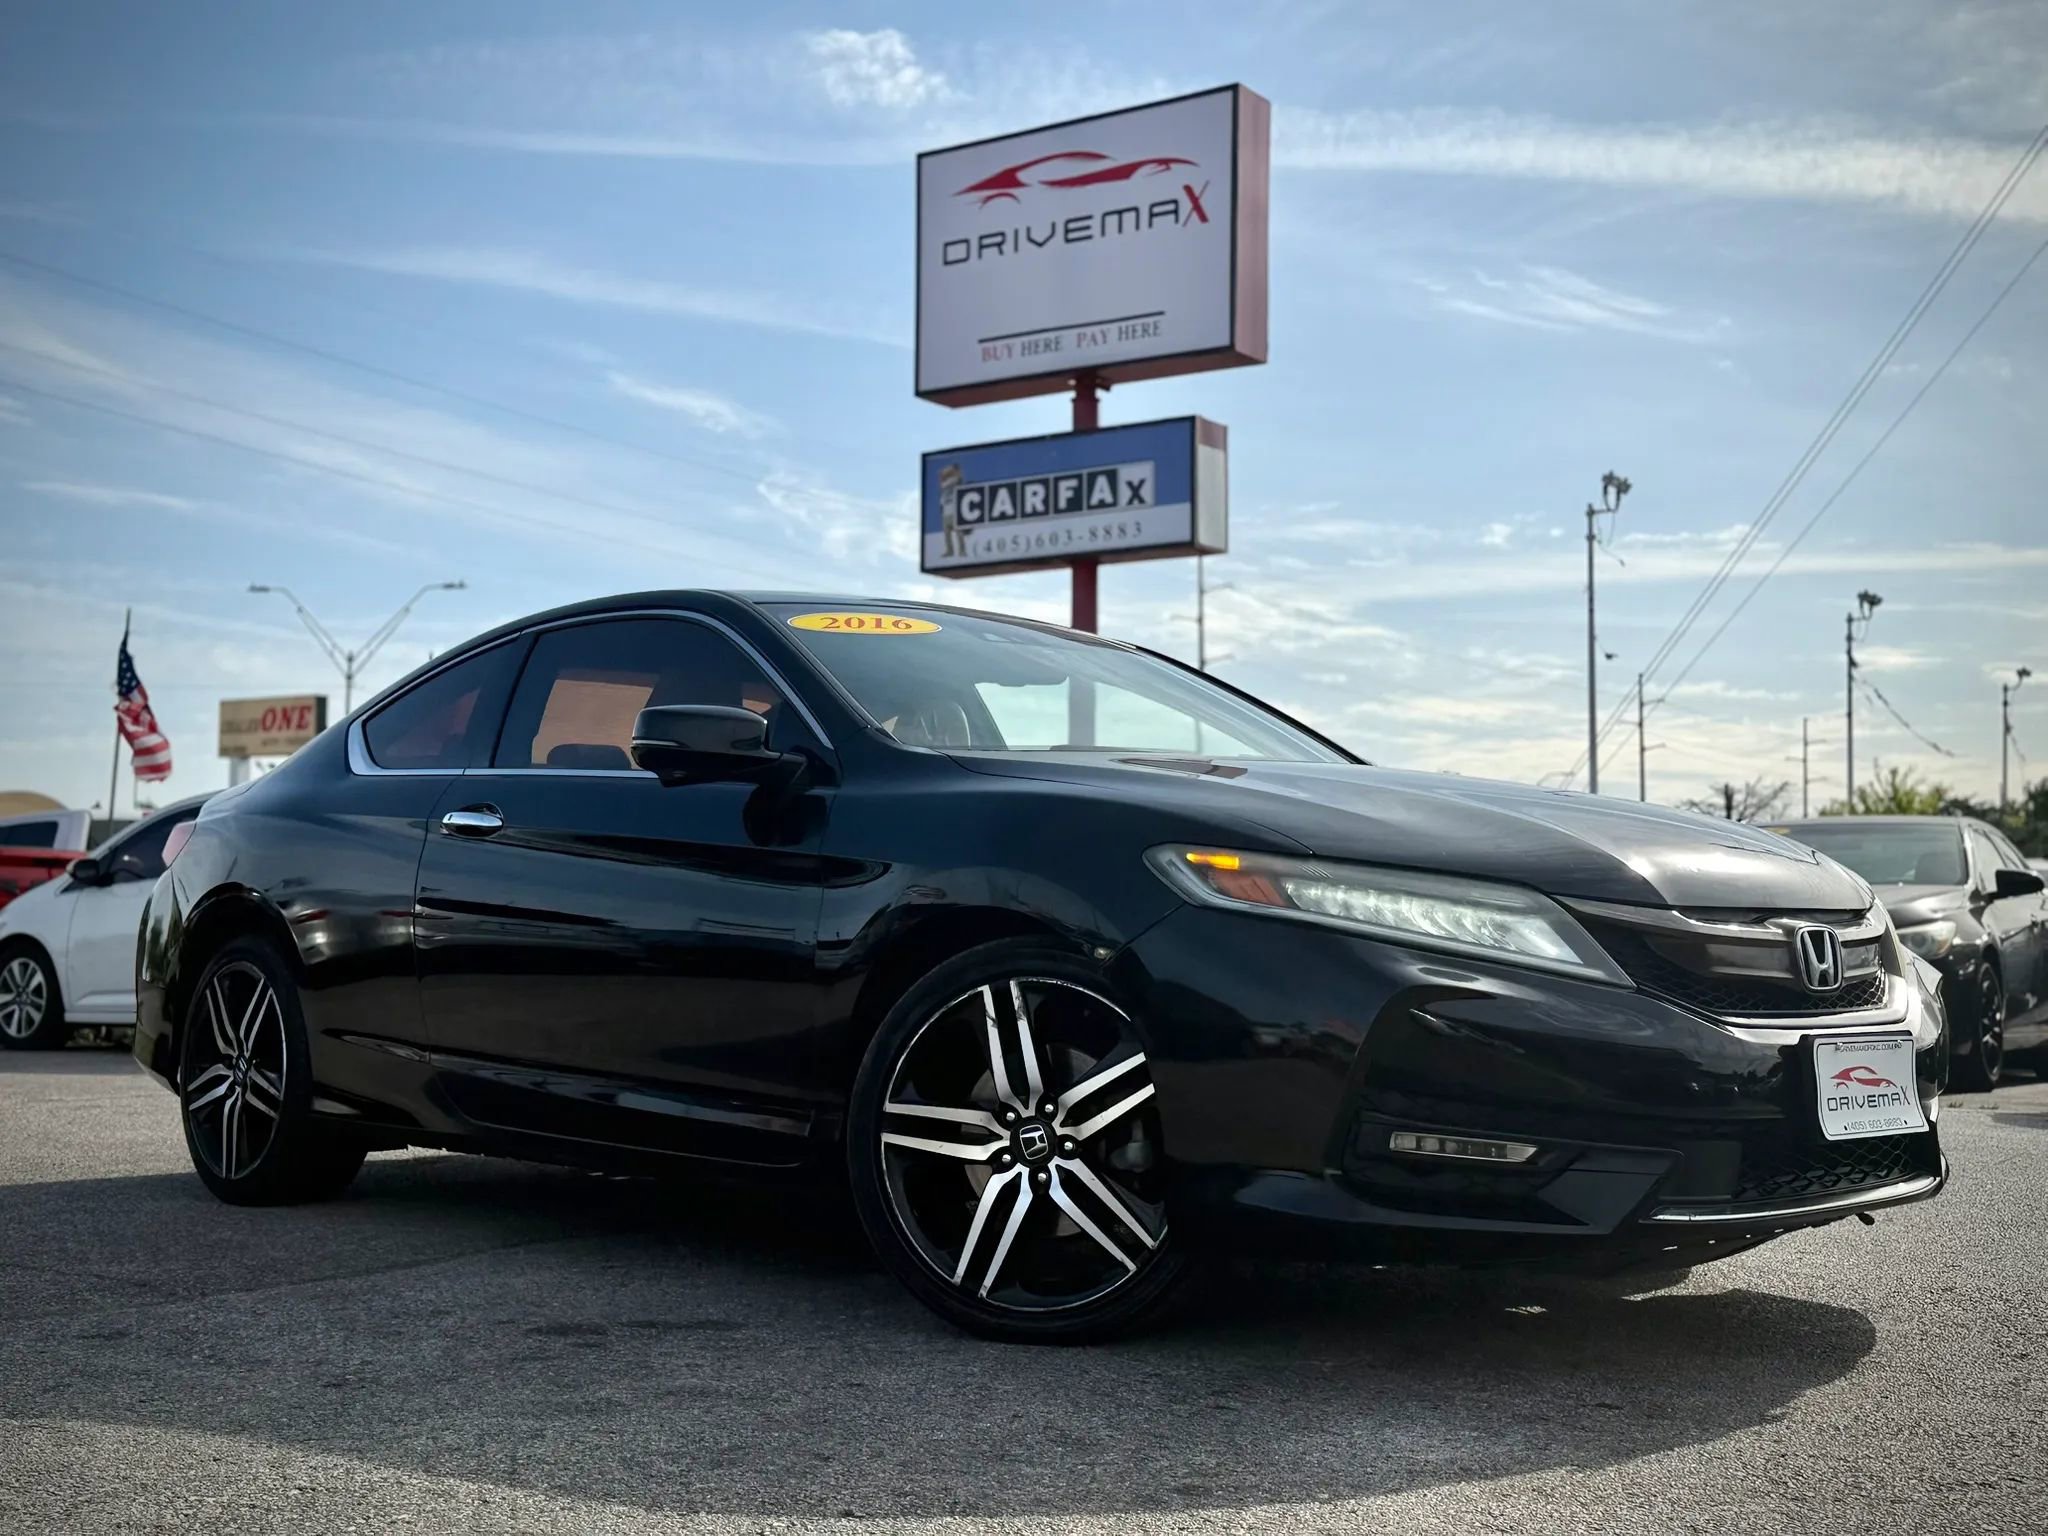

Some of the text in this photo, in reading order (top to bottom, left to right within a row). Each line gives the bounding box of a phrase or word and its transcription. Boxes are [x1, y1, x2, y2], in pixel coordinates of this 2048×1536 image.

[942, 179, 1210, 266] DRIVEMAX
[982, 320, 1162, 362] BUY HERE PAY HERE
[960, 474, 1147, 522] CARFAX
[820, 617, 913, 630] 2016
[261, 705, 312, 732] ONE
[1827, 1085, 1910, 1112] DRIVEMAX
